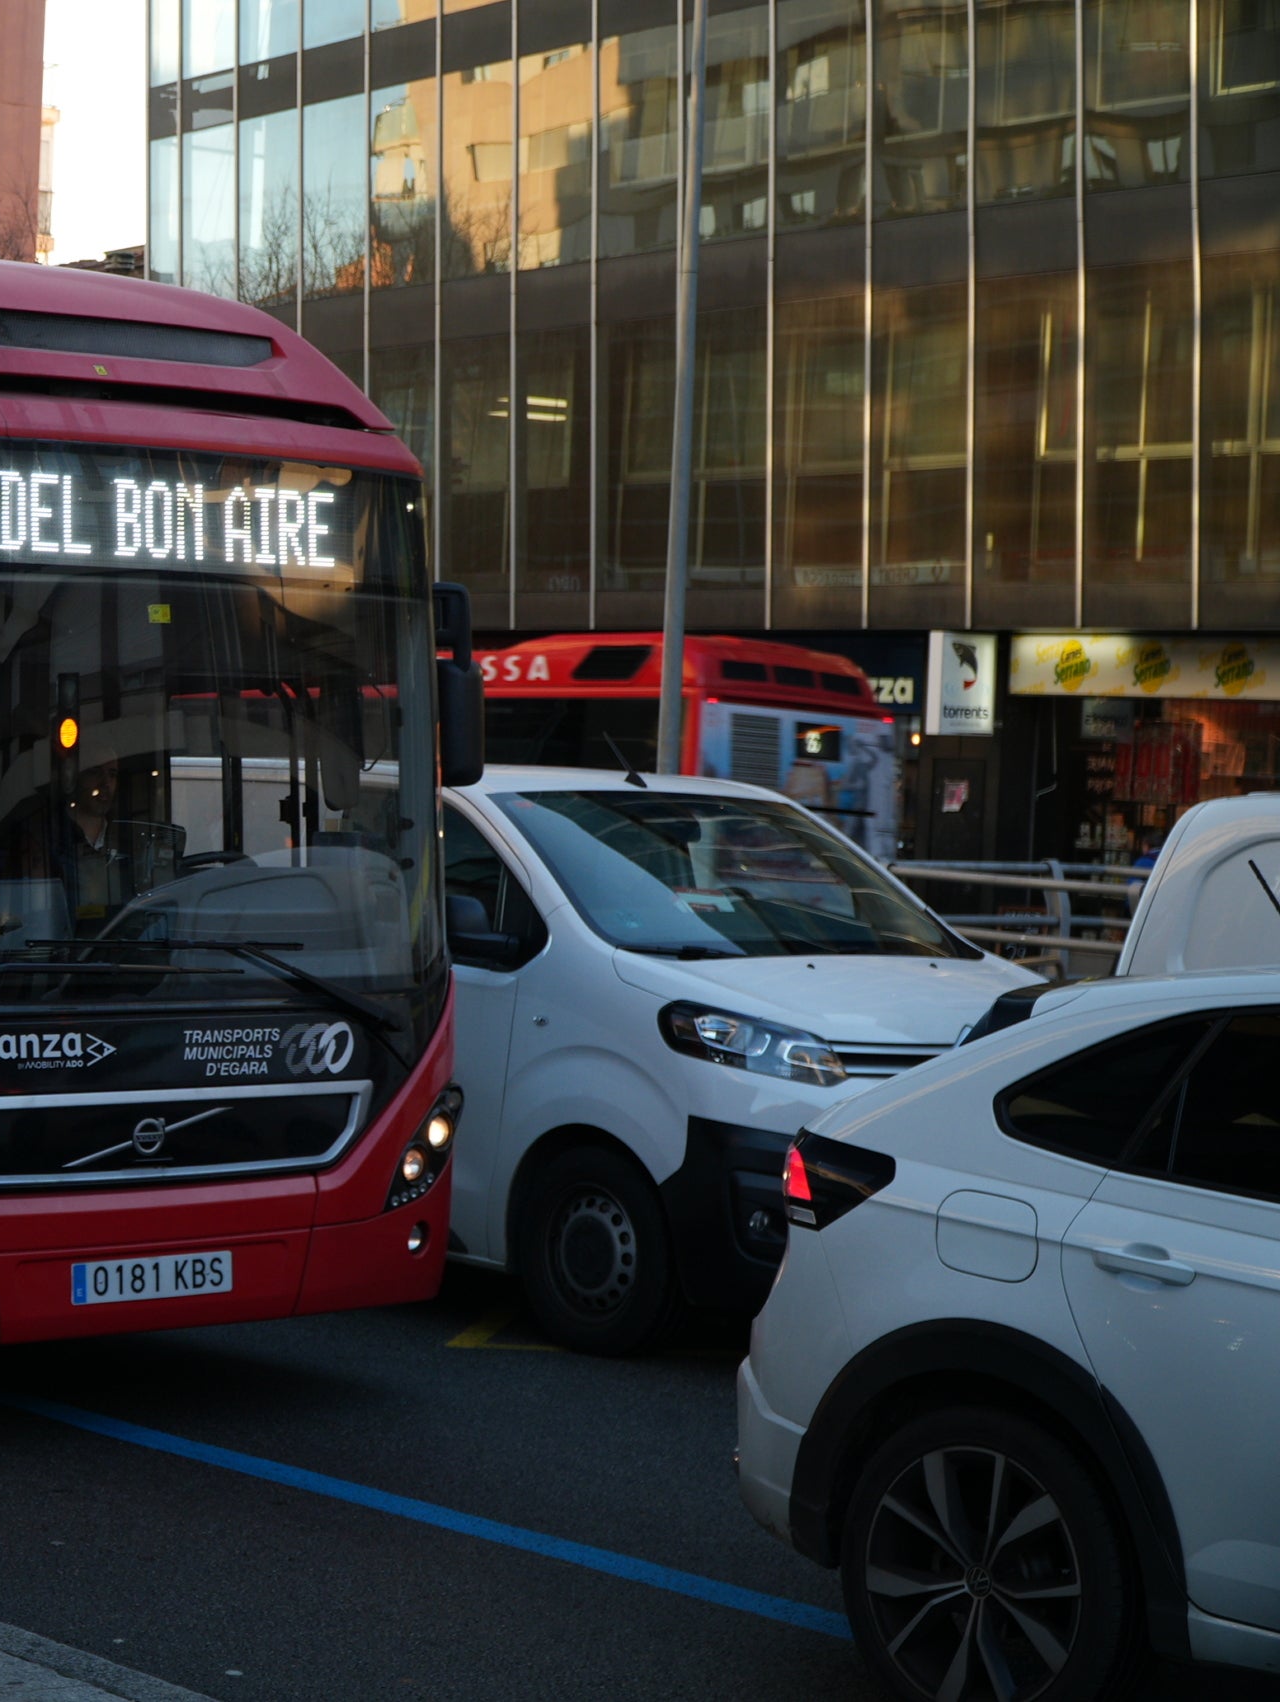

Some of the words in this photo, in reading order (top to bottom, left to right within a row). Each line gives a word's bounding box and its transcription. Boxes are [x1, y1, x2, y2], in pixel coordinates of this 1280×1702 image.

[114, 478, 204, 560] BON
[224, 486, 335, 567] AIRE
[943, 705, 989, 719] torrents
[183, 1027, 281, 1044] TRANSPORTS
[183, 1044, 273, 1061] MUNICIPALS
[65, 1059, 84, 1068] ADO
[205, 1060, 269, 1077] D'EGARA
[93, 1262, 160, 1297] 0181
[174, 1256, 224, 1291] KBS
